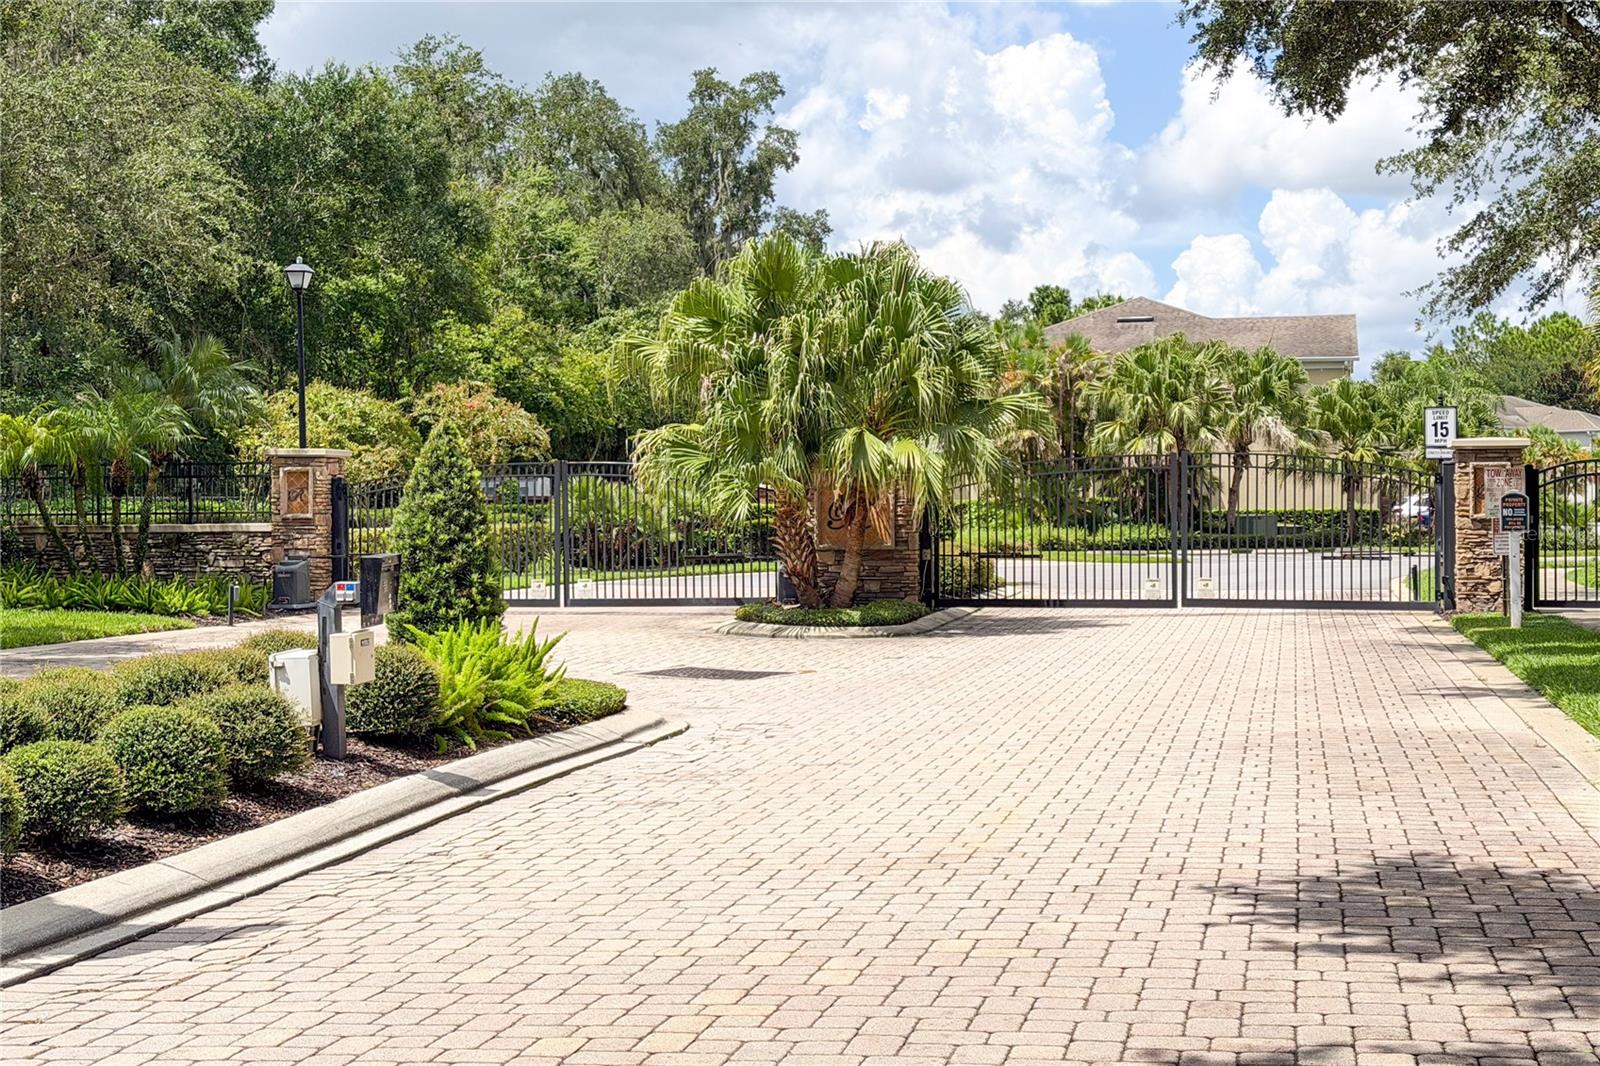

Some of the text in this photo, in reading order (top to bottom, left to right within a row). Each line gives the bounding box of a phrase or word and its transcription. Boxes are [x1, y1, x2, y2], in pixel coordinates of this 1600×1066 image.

[1431, 421, 1449, 438] 15
[1496, 478, 1512, 487] ZONE
[1502, 508, 1513, 517] NO
